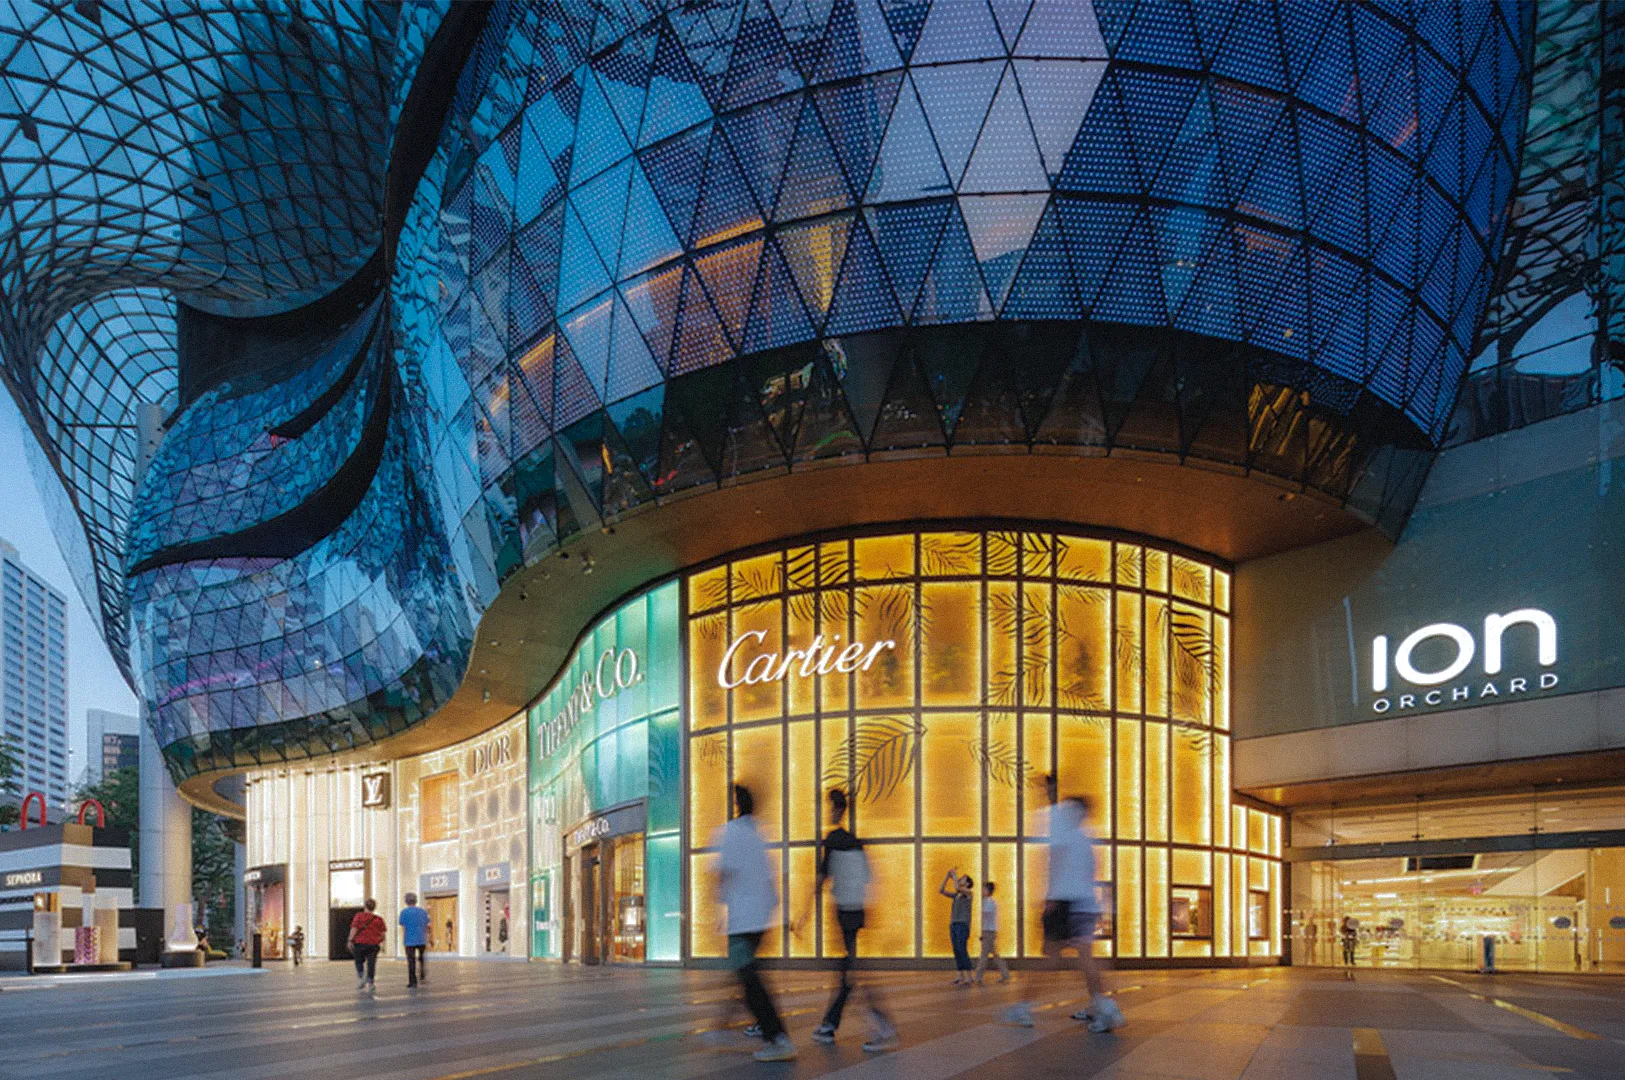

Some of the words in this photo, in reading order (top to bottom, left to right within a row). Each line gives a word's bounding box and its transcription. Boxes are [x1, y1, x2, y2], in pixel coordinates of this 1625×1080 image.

[717, 629, 896, 689] Cartier
[1373, 673, 1559, 713] ORCHARD
[473, 735, 511, 774] DIOR
